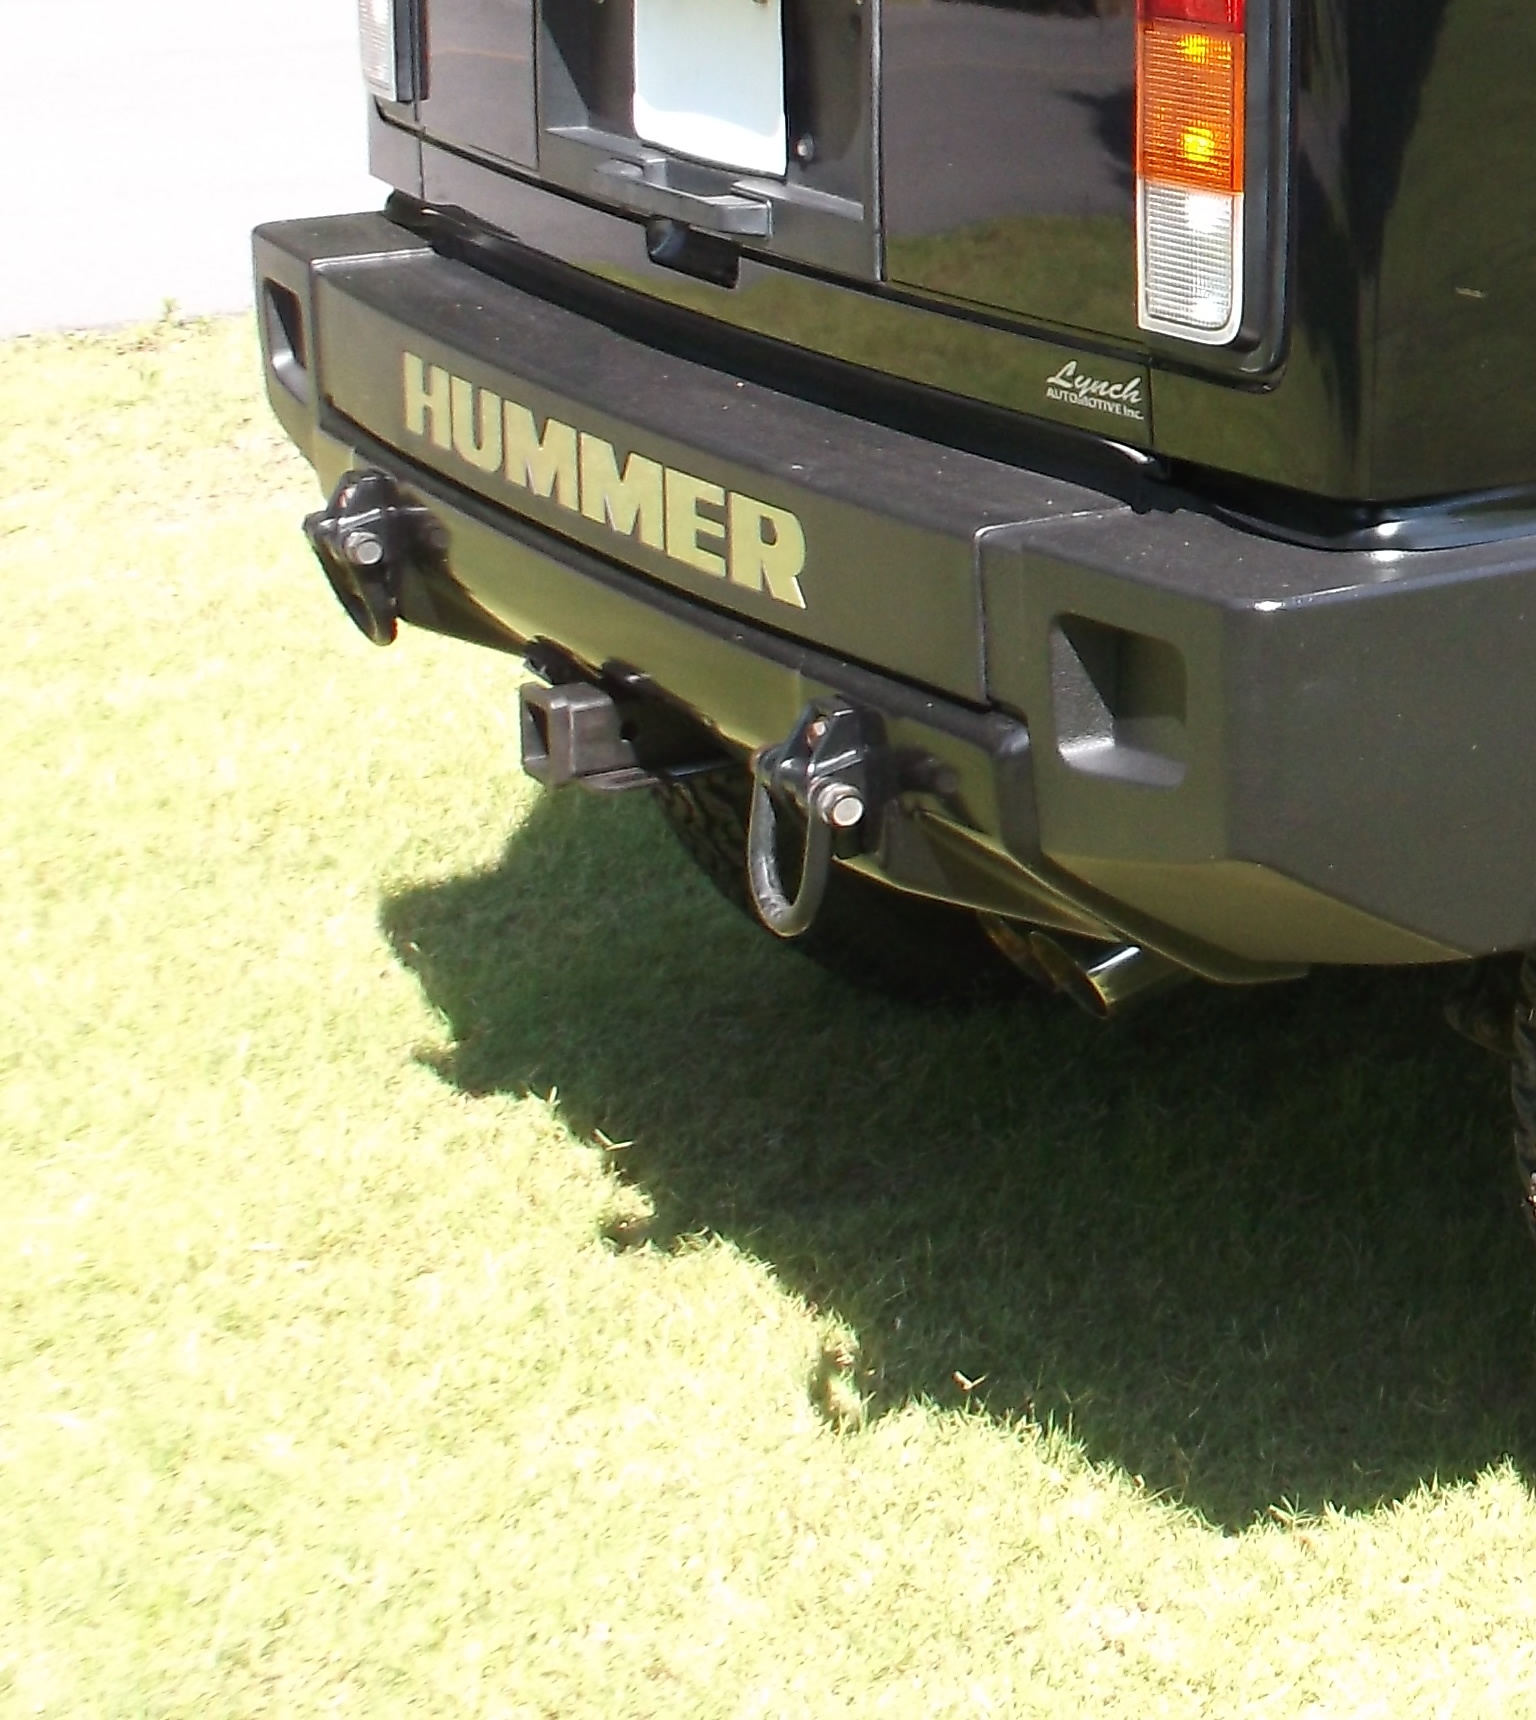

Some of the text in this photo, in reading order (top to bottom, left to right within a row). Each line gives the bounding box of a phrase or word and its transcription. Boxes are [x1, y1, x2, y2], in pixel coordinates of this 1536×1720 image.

[1046, 360, 1142, 403] Lynch
[1046, 386, 1121, 415] AUTOMOTIVE
[402, 350, 807, 609] HUMMER
